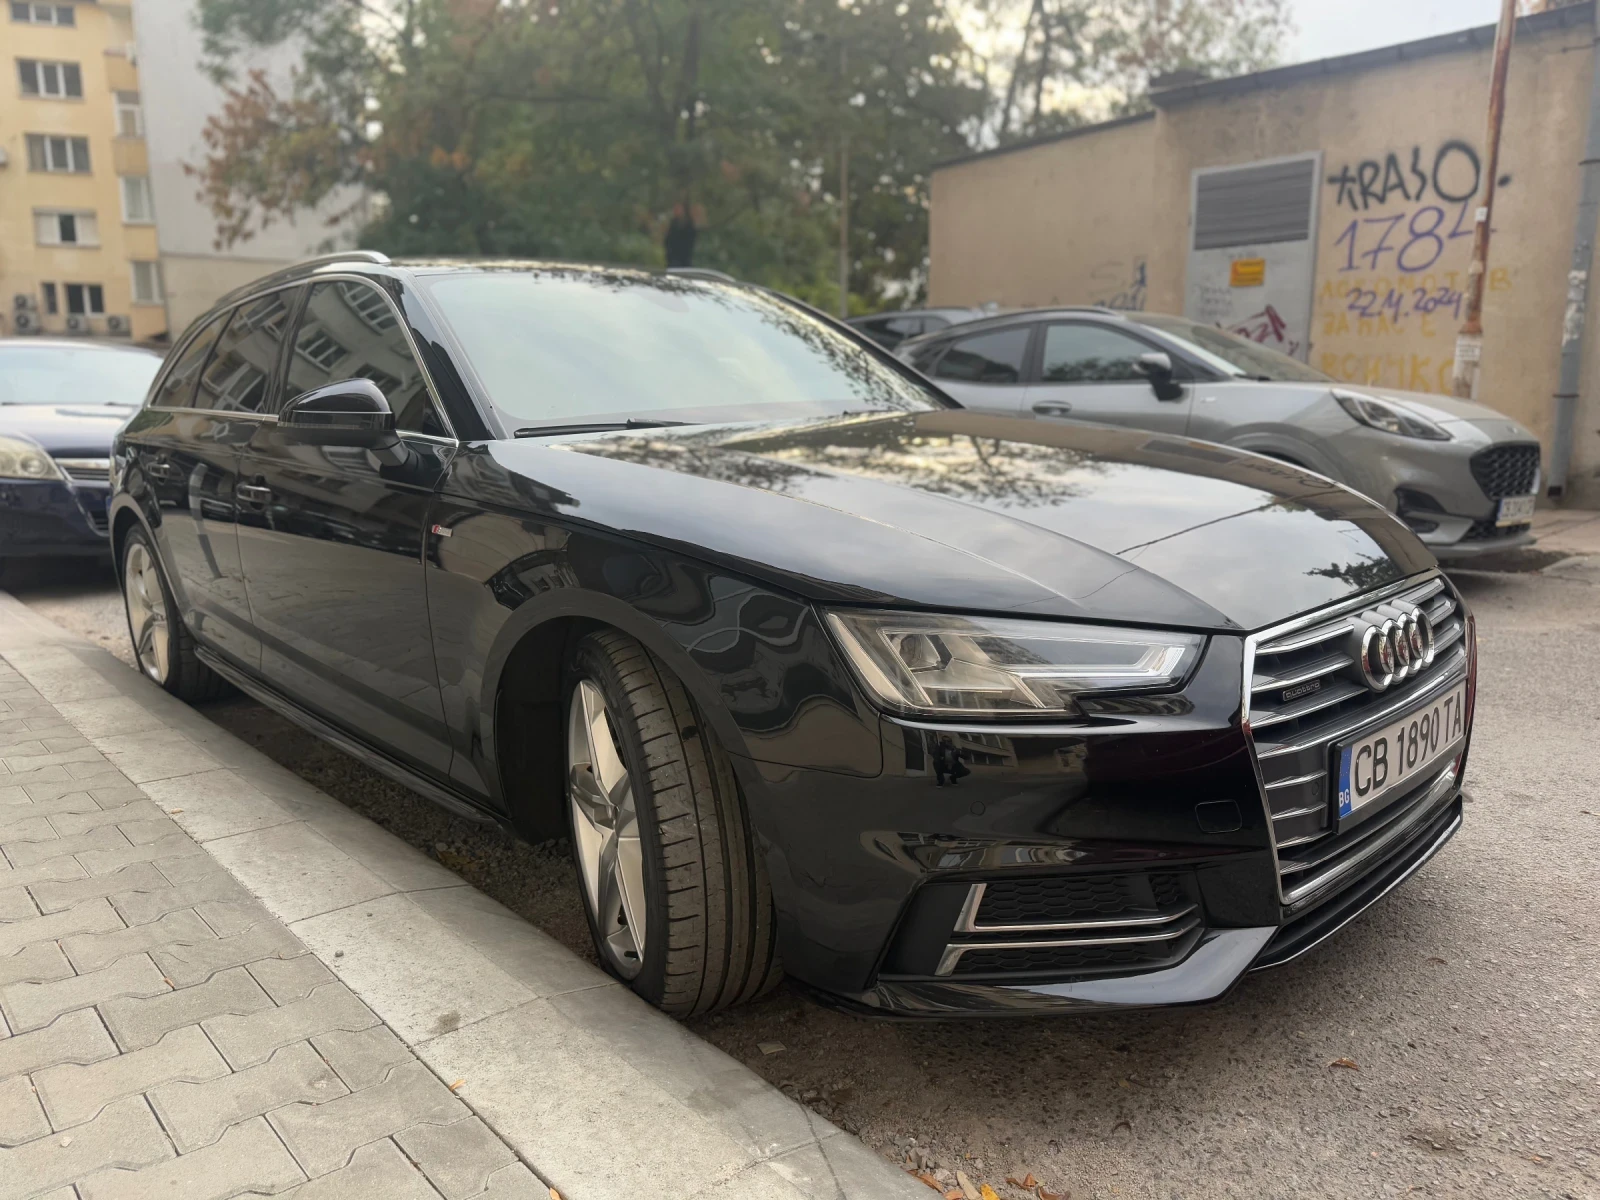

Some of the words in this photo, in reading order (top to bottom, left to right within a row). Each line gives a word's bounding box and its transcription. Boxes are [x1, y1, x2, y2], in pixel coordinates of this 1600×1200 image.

[1285, 682, 1320, 699] quattro
[1354, 737, 1388, 797] CB
[1396, 706, 1440, 776] 1890
[1443, 691, 1461, 744] TA
[1338, 788, 1350, 808] BG
